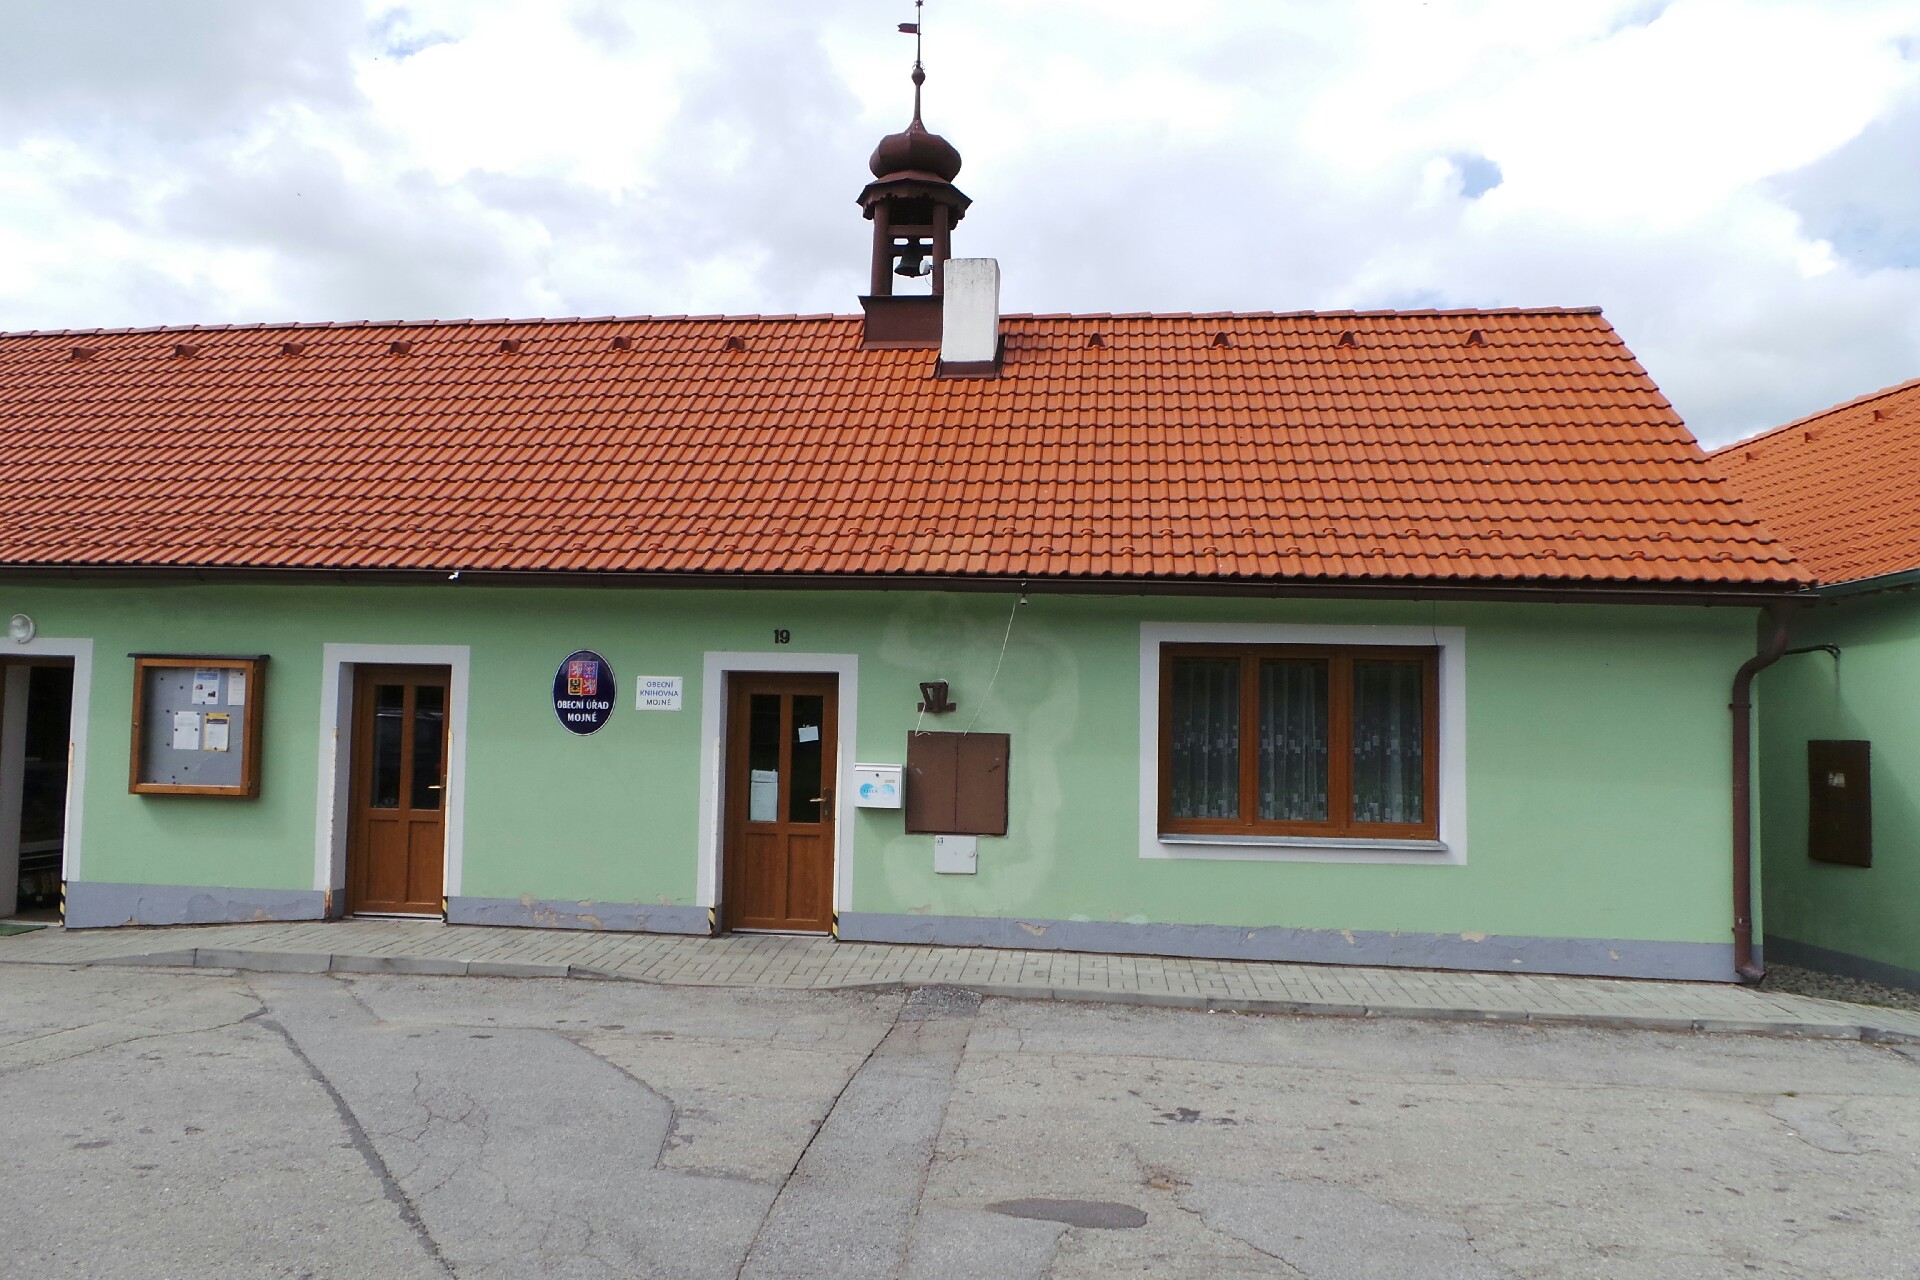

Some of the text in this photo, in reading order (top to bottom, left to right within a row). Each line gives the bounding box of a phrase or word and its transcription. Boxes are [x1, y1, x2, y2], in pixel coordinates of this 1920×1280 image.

[774, 629, 790, 644] 19
[646, 680, 674, 688] OBECNÍ
[639, 689, 679, 697] KNIHOVNA
[557, 699, 609, 710] OBECNÍ ÚŘAD
[646, 698, 672, 706] MOJNÉ
[567, 712, 598, 723] MOJNÉ
